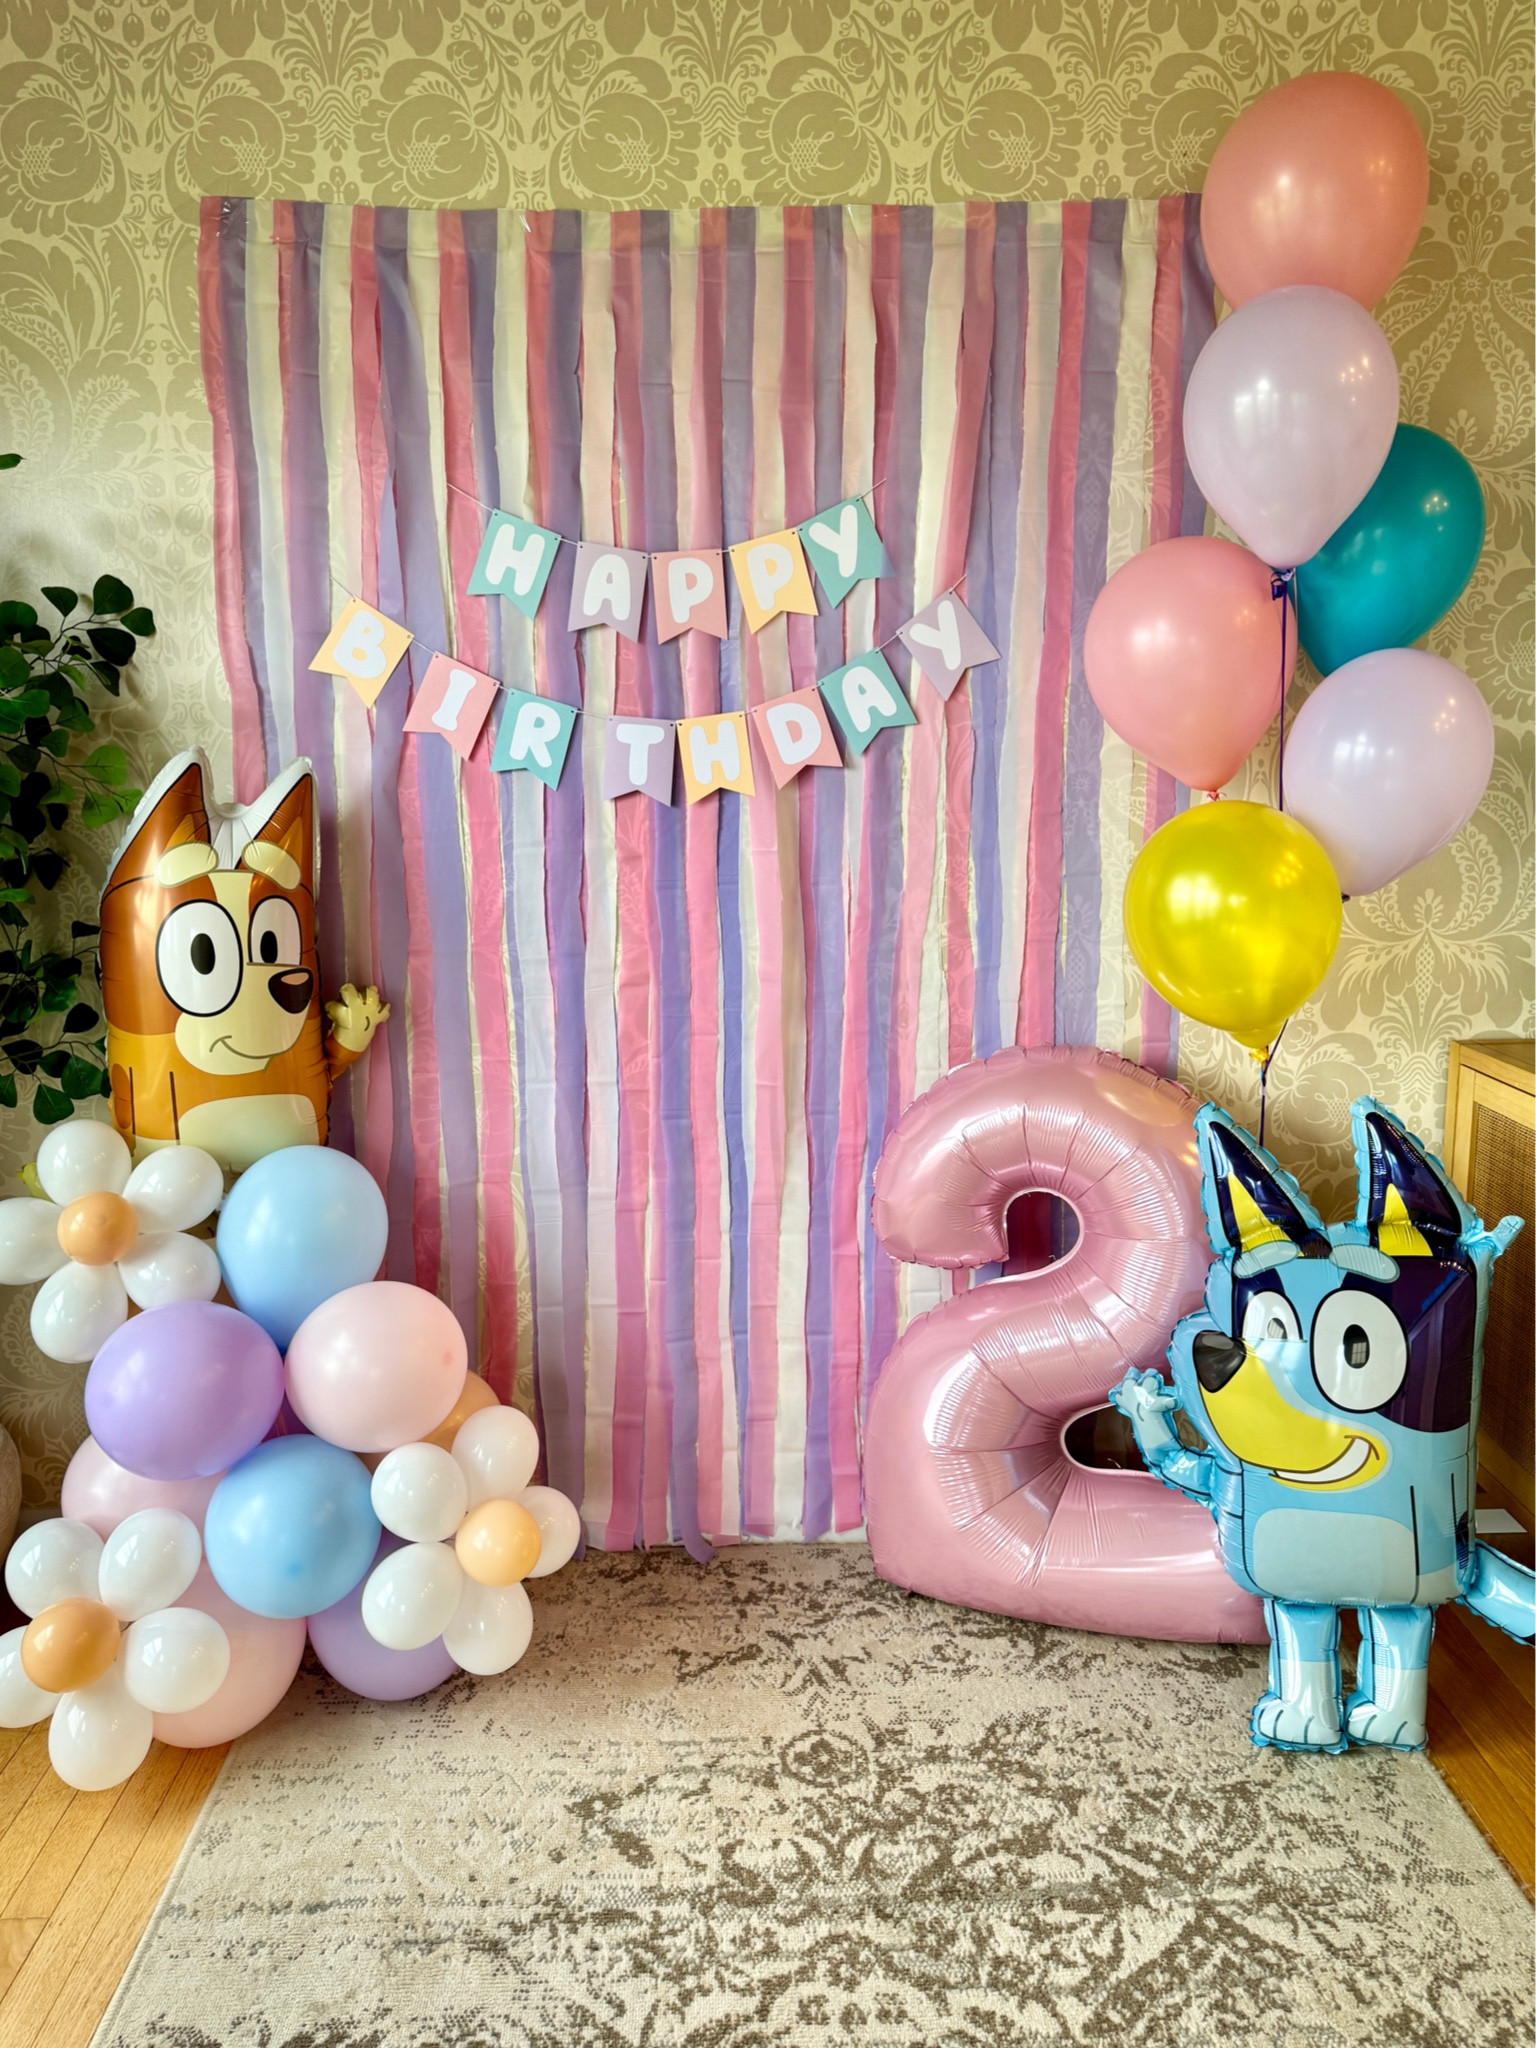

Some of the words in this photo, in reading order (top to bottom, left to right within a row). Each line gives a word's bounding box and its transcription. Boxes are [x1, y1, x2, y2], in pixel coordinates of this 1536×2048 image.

[485, 504, 860, 623] HAPPY
[333, 600, 962, 785] BIRTHDAY
[866, 1046, 1268, 1645] 2
